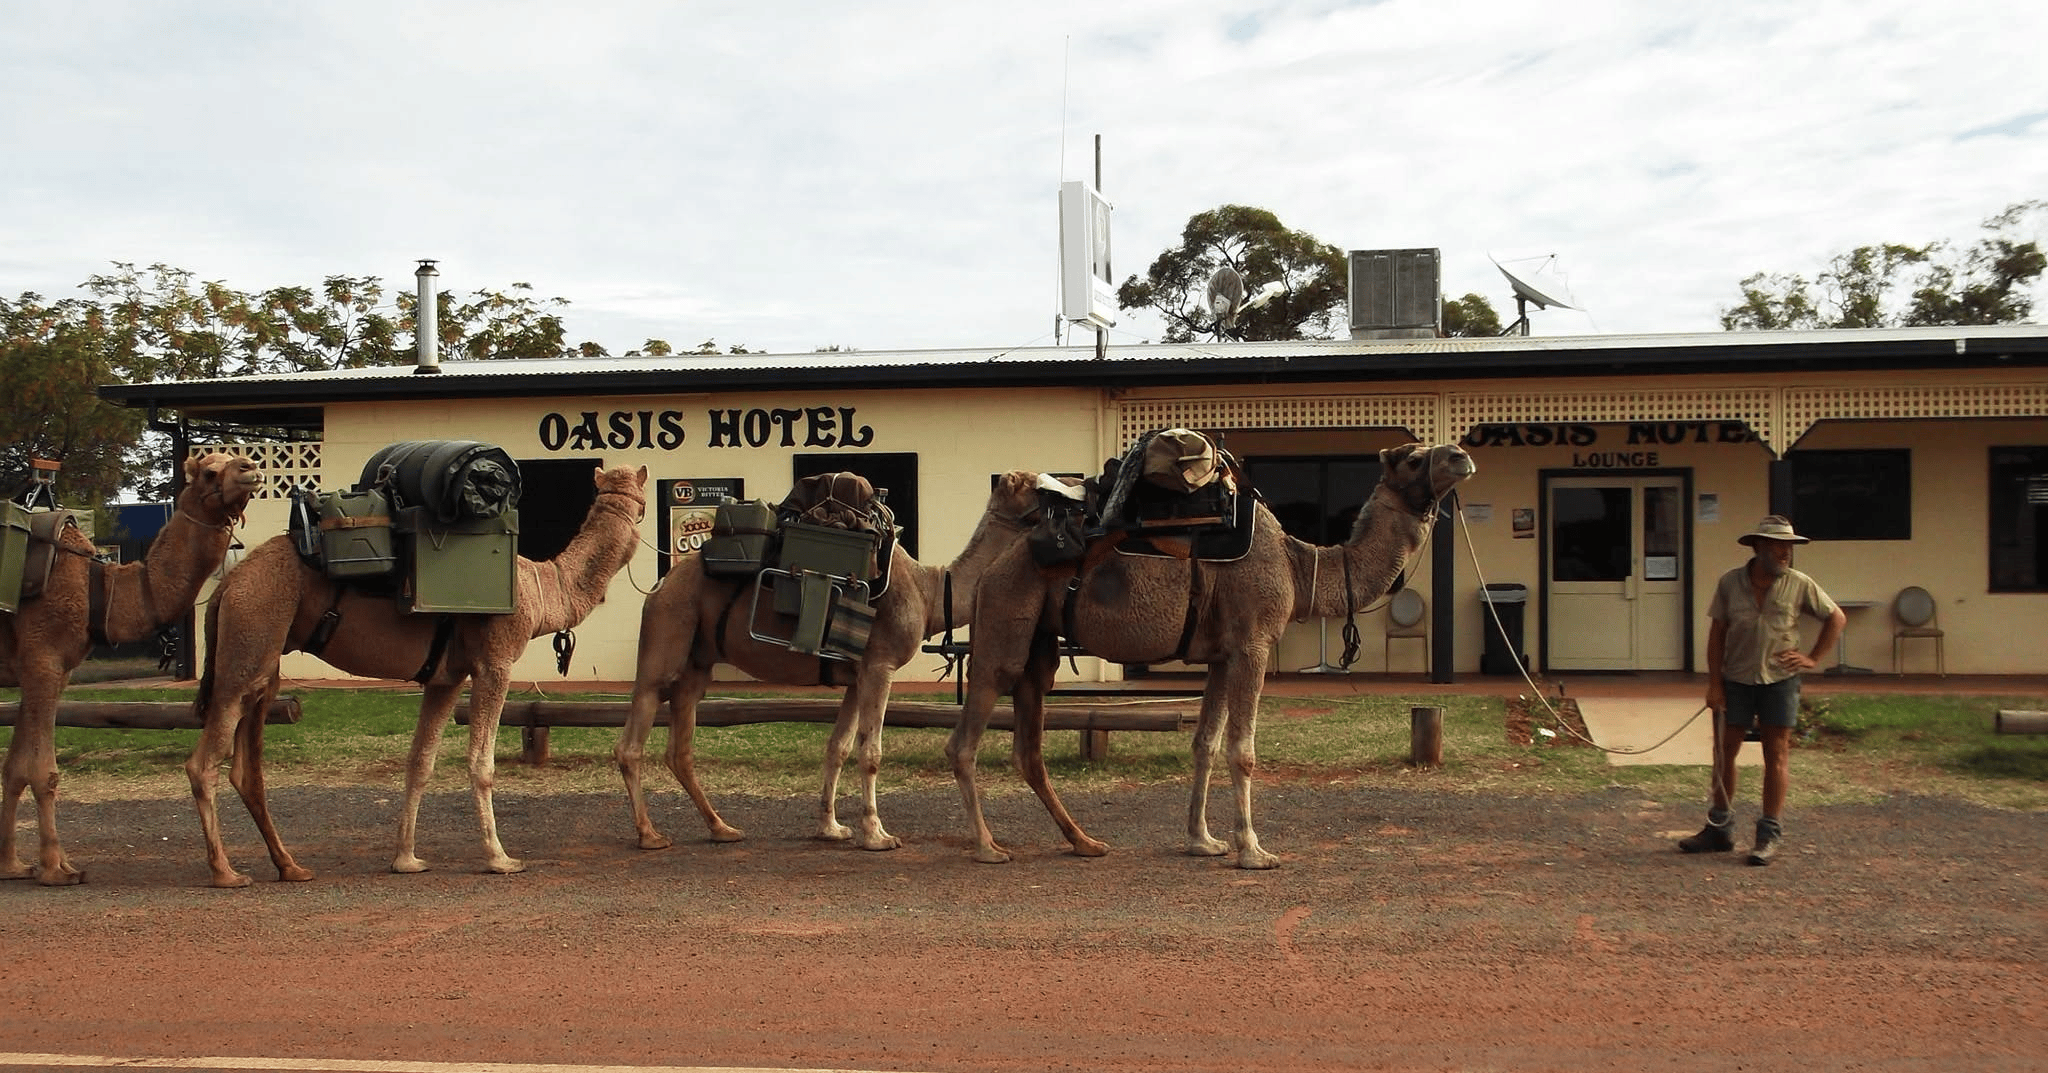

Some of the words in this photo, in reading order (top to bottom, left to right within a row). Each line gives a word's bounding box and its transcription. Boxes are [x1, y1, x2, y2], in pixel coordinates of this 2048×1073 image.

[538, 410, 686, 451] OASIS
[707, 406, 875, 449] HOTEL
[1626, 422, 1759, 445] HOTE
[1572, 451, 1660, 468] LOUNGE
[675, 487, 692, 497] VB
[684, 521, 711, 533] XXXX
